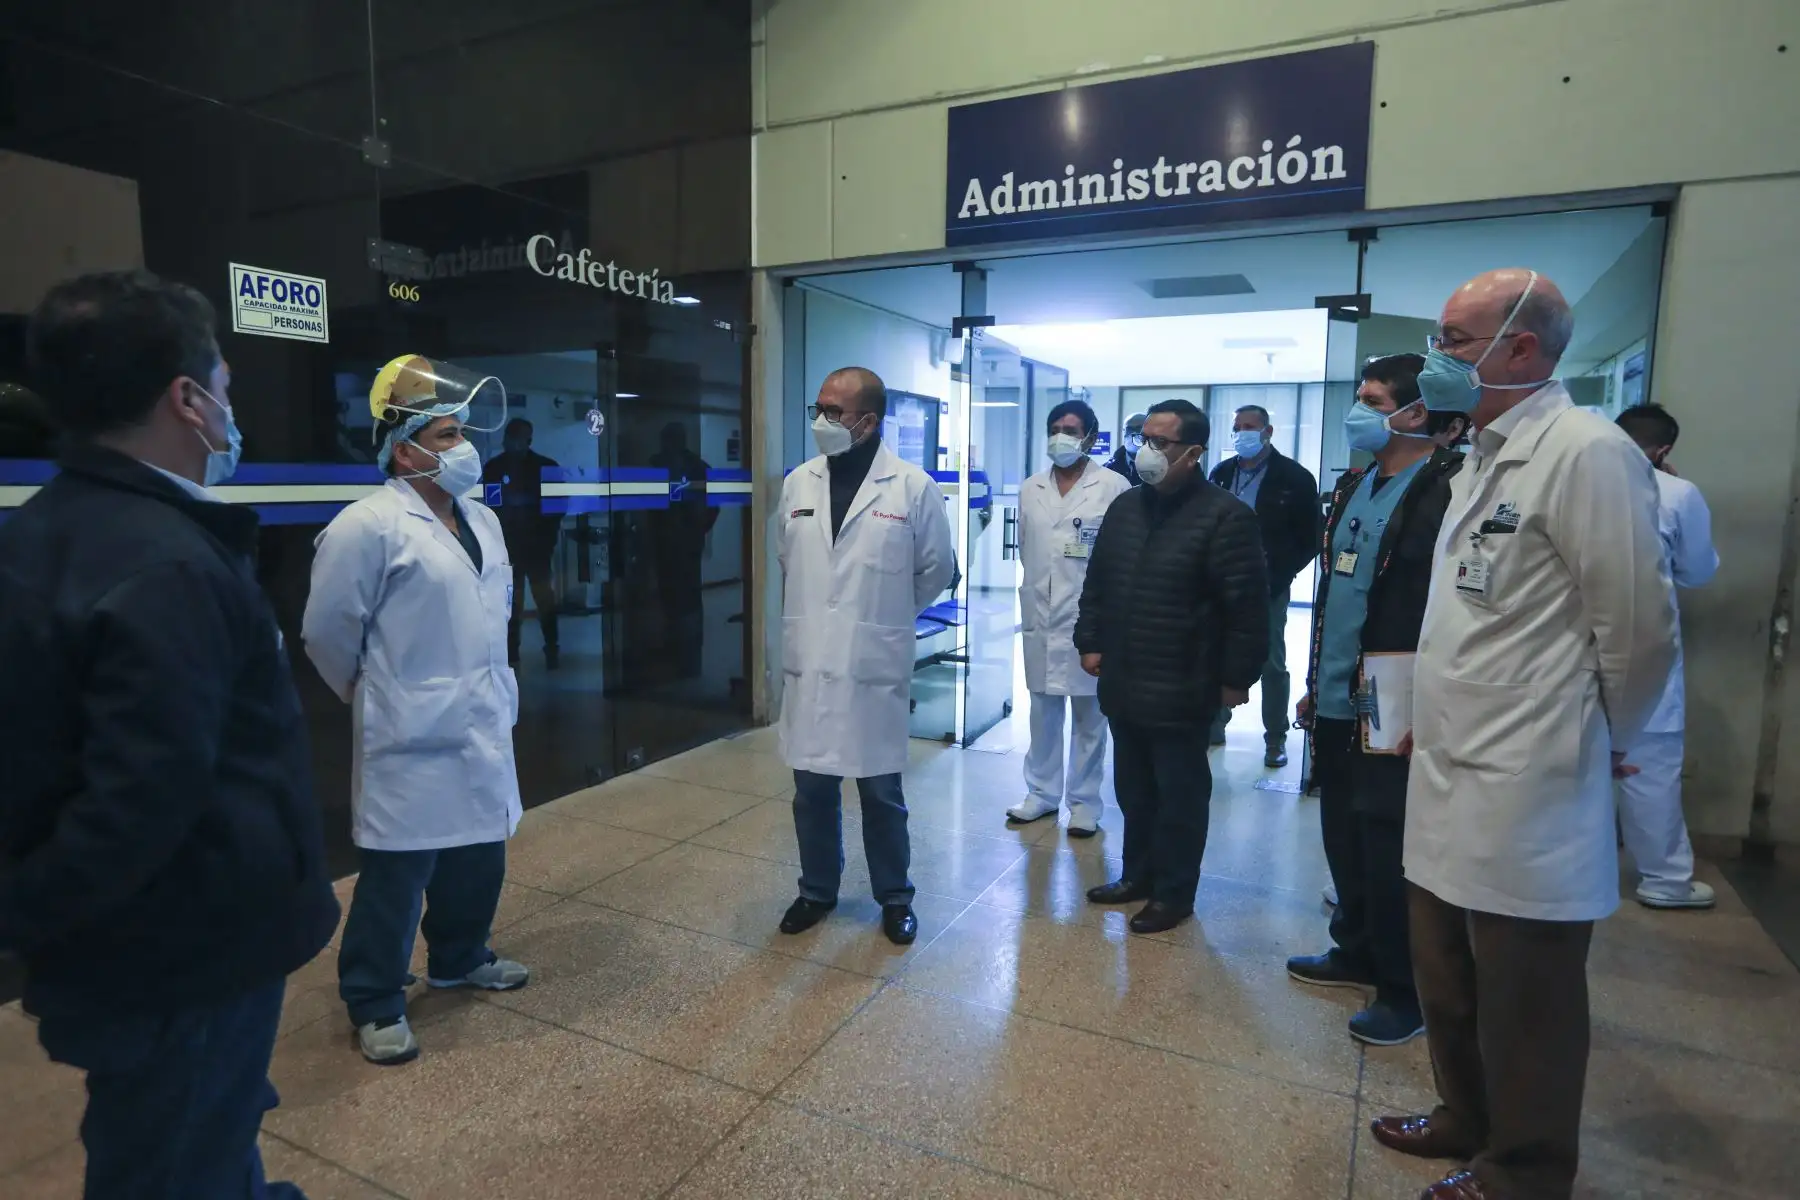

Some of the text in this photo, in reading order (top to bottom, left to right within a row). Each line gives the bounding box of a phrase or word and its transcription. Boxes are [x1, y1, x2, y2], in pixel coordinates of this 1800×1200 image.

[958, 134, 1347, 219] Administración
[526, 234, 676, 305] Cafetería
[239, 273, 321, 308] AFORO
[388, 282, 420, 302] 606
[243, 299, 288, 311] CAPACIDAD
[274, 316, 323, 333] PERSONAS
